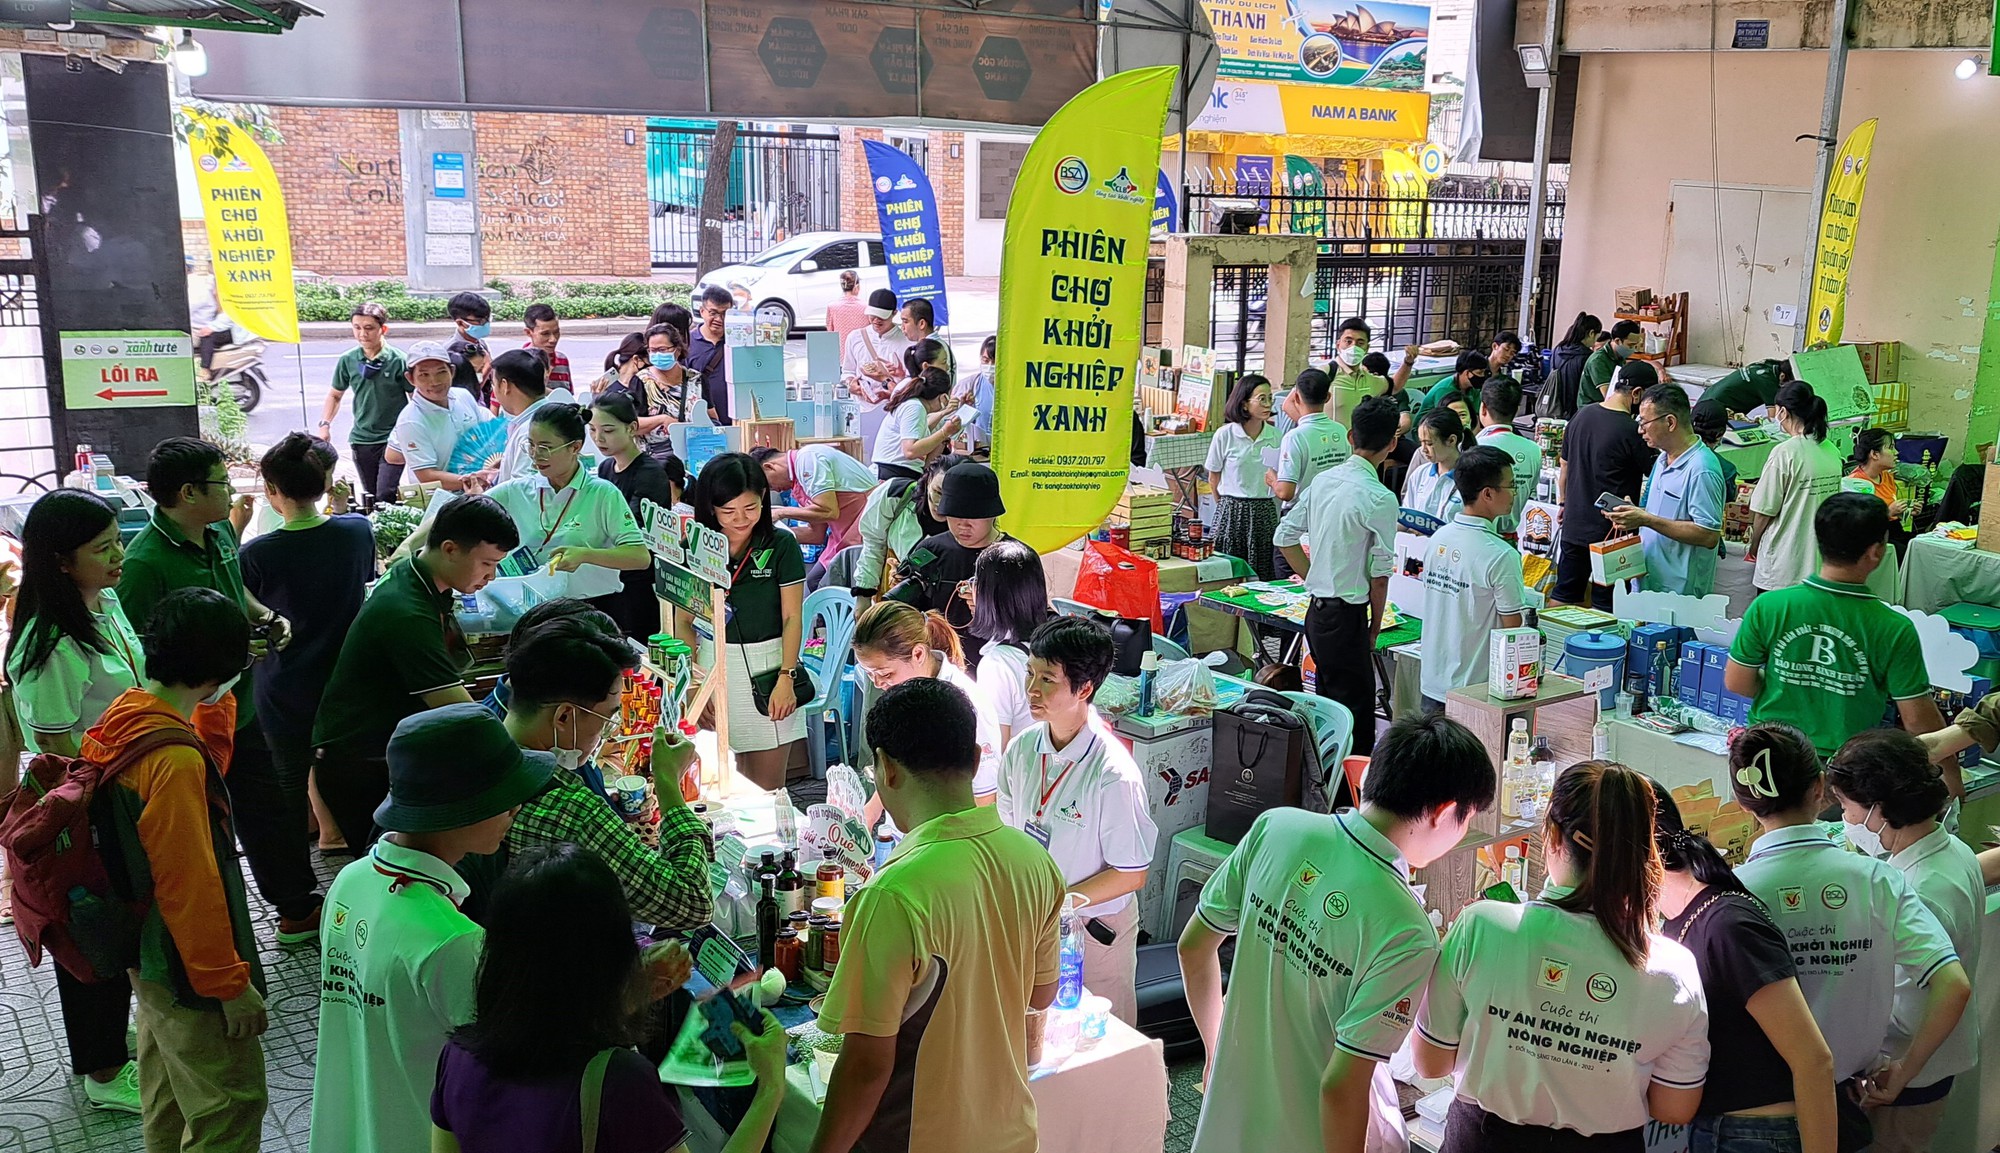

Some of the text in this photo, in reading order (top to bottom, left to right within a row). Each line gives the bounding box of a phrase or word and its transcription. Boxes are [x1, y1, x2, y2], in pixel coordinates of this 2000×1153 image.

[1210, 9, 1267, 30] THANH
[1312, 104, 1398, 122] NAM A BANK
[886, 199, 924, 216] PHIÊN
[1041, 228, 1126, 265] PHIÊN
[227, 269, 273, 283] XANH
[897, 266, 932, 280] XANH
[1051, 274, 1112, 312] CHỢ
[1779, 309, 1791, 320] 17
[1043, 313, 1113, 349] KHỞI
[101, 363, 159, 383] LỐI RA
[1025, 359, 1125, 397] NGHIỆP
[1032, 404, 1107, 432] XANH
[1028, 455, 1106, 466] Hotline: 0937.201.797
[657, 510, 678, 530] OCOP
[702, 532, 724, 553] OCOP
[1183, 766, 1210, 789] SA
[1284, 899, 1324, 936] Cuộc thi
[1250, 892, 1265, 911] DỰ
[1263, 904, 1280, 919] ÁN
[1280, 915, 1308, 943] KHỞI
[1307, 940, 1353, 978] NGHIỆP
[1819, 924, 1836, 936] thi
[1257, 916, 1289, 943] NÔNG
[1288, 941, 1329, 978] NGHIỆP
[1790, 938, 1825, 952] KHỞI
[1809, 952, 1857, 967] NGHIỆP
[329, 964, 356, 982] KHỞ
[1591, 978, 1613, 993] BSA
[1382, 1010, 1396, 1019] QUI
[1540, 1000, 1600, 1025] Cuộc thi
[1488, 1004, 1642, 1056] DỰ ÁN KHỞI NGHIỆP
[1507, 1027, 1618, 1064] NÔNG NGHIỆP
